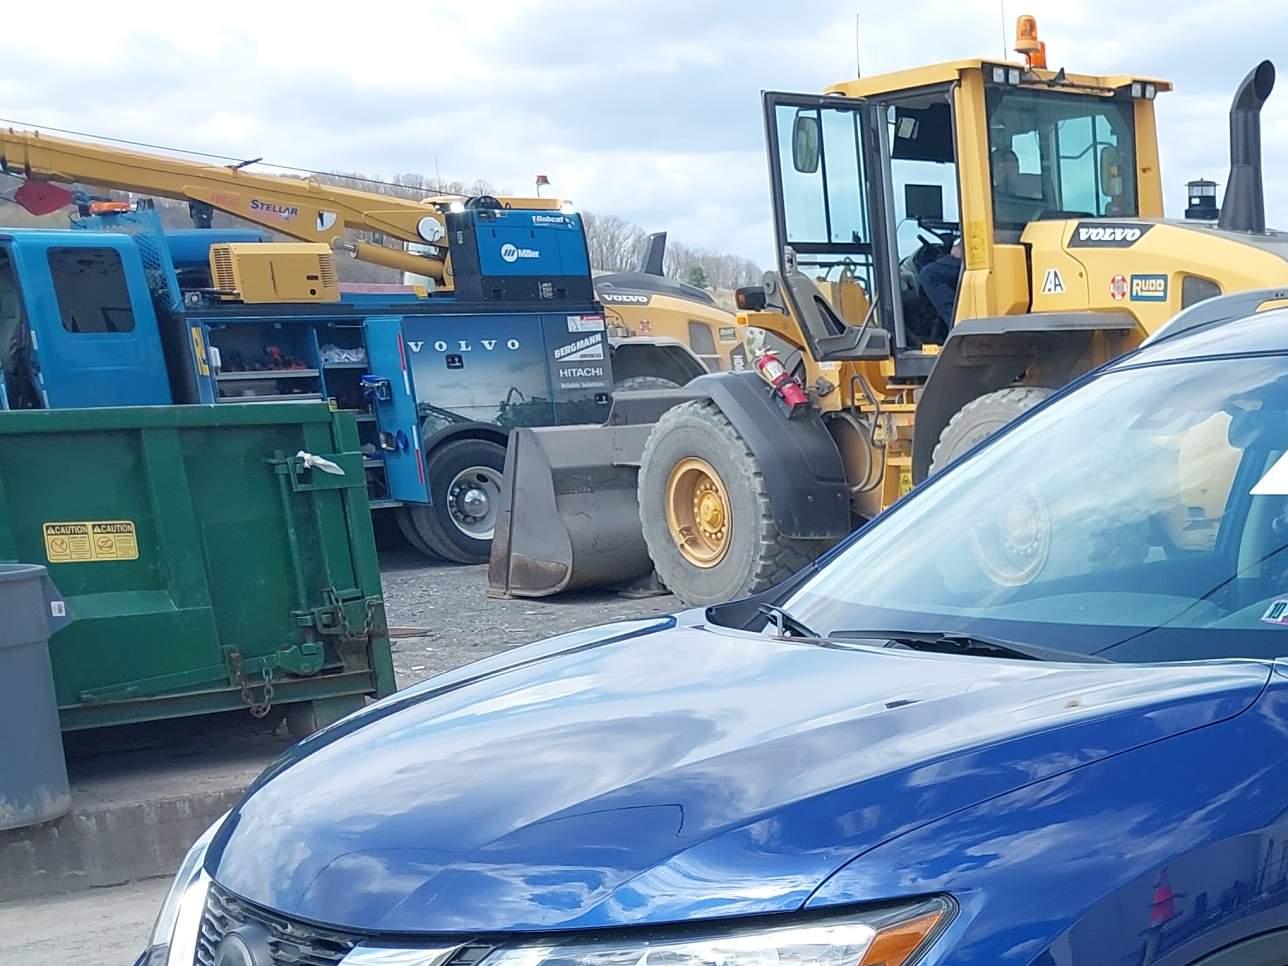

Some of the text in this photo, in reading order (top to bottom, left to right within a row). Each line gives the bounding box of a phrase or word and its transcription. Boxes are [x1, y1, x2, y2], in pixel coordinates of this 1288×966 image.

[251, 199, 298, 216] STELLAR
[1079, 228, 1141, 241] VOLVO
[1132, 279, 1165, 297] RUDD
[602, 294, 648, 303] VOLVO
[407, 339, 520, 352] VOLVO
[554, 333, 602, 359] BERGMANN
[559, 367, 603, 378] HITACHI
[54, 525, 88, 534] CAUTION
[100, 524, 133, 533] CAUTION
